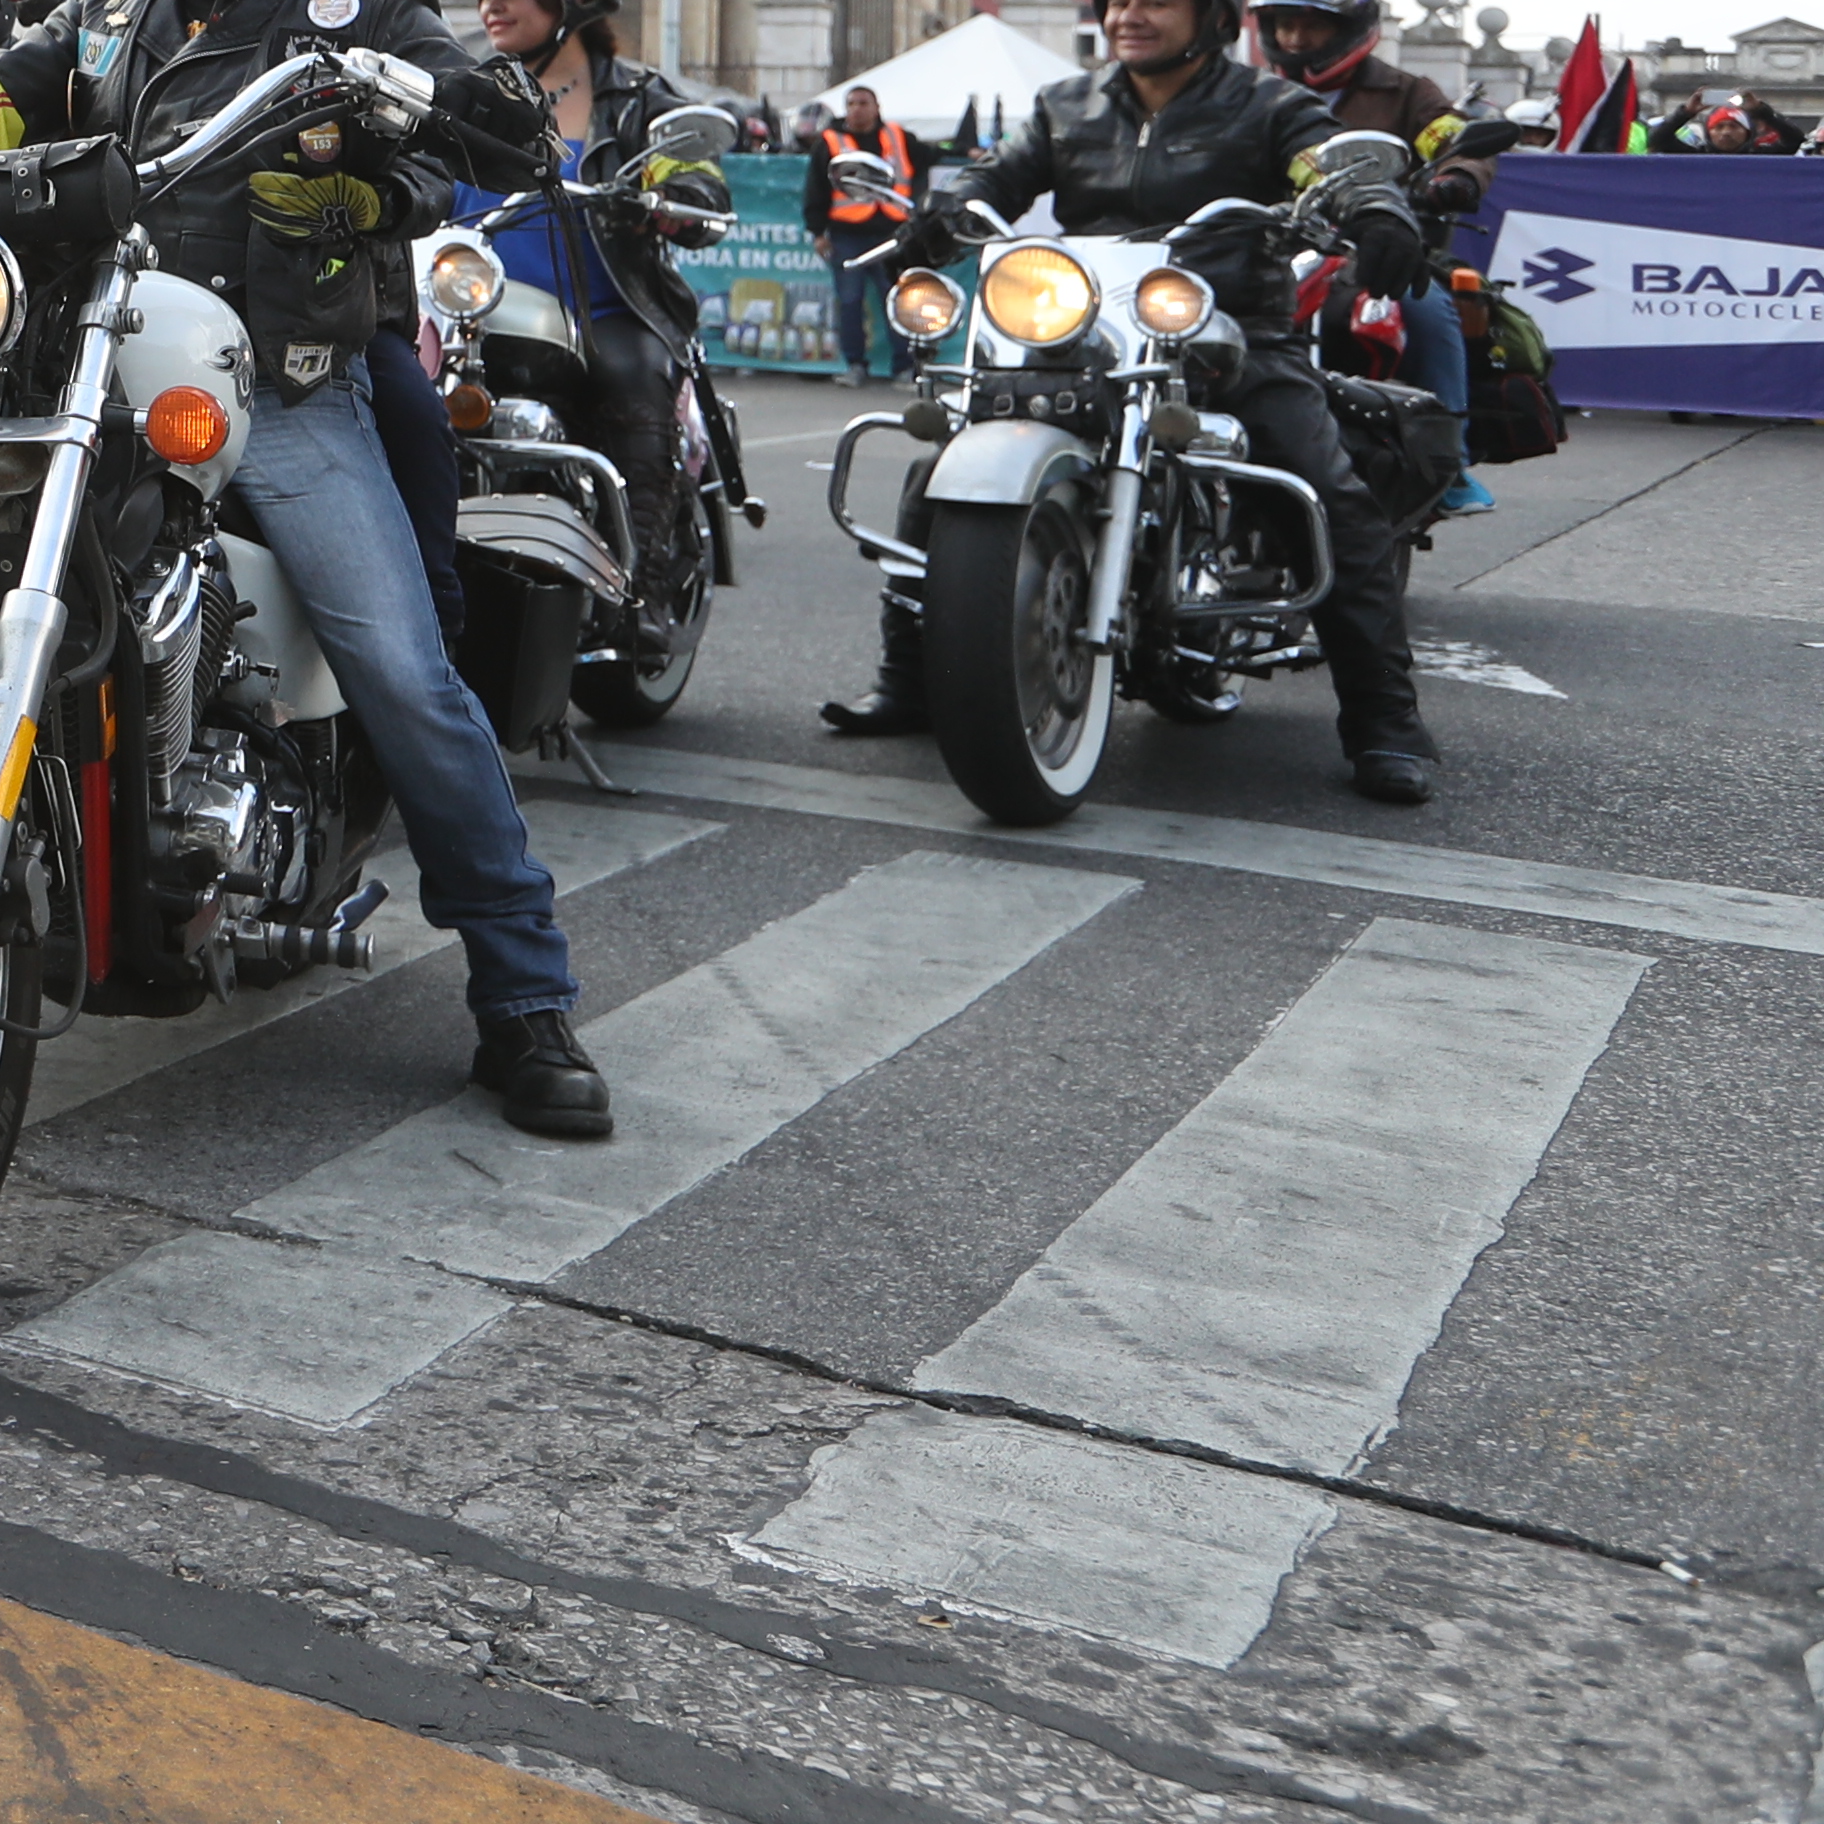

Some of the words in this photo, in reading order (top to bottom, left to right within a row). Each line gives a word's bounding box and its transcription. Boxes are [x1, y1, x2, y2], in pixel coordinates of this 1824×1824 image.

[313, 139, 332, 150] 153
[725, 223, 798, 244] ANTES
[739, 249, 770, 269] EN
[773, 250, 827, 272] GUA
[1632, 264, 1824, 298] BAJA
[1631, 300, 1823, 321] MOTOCICLE
